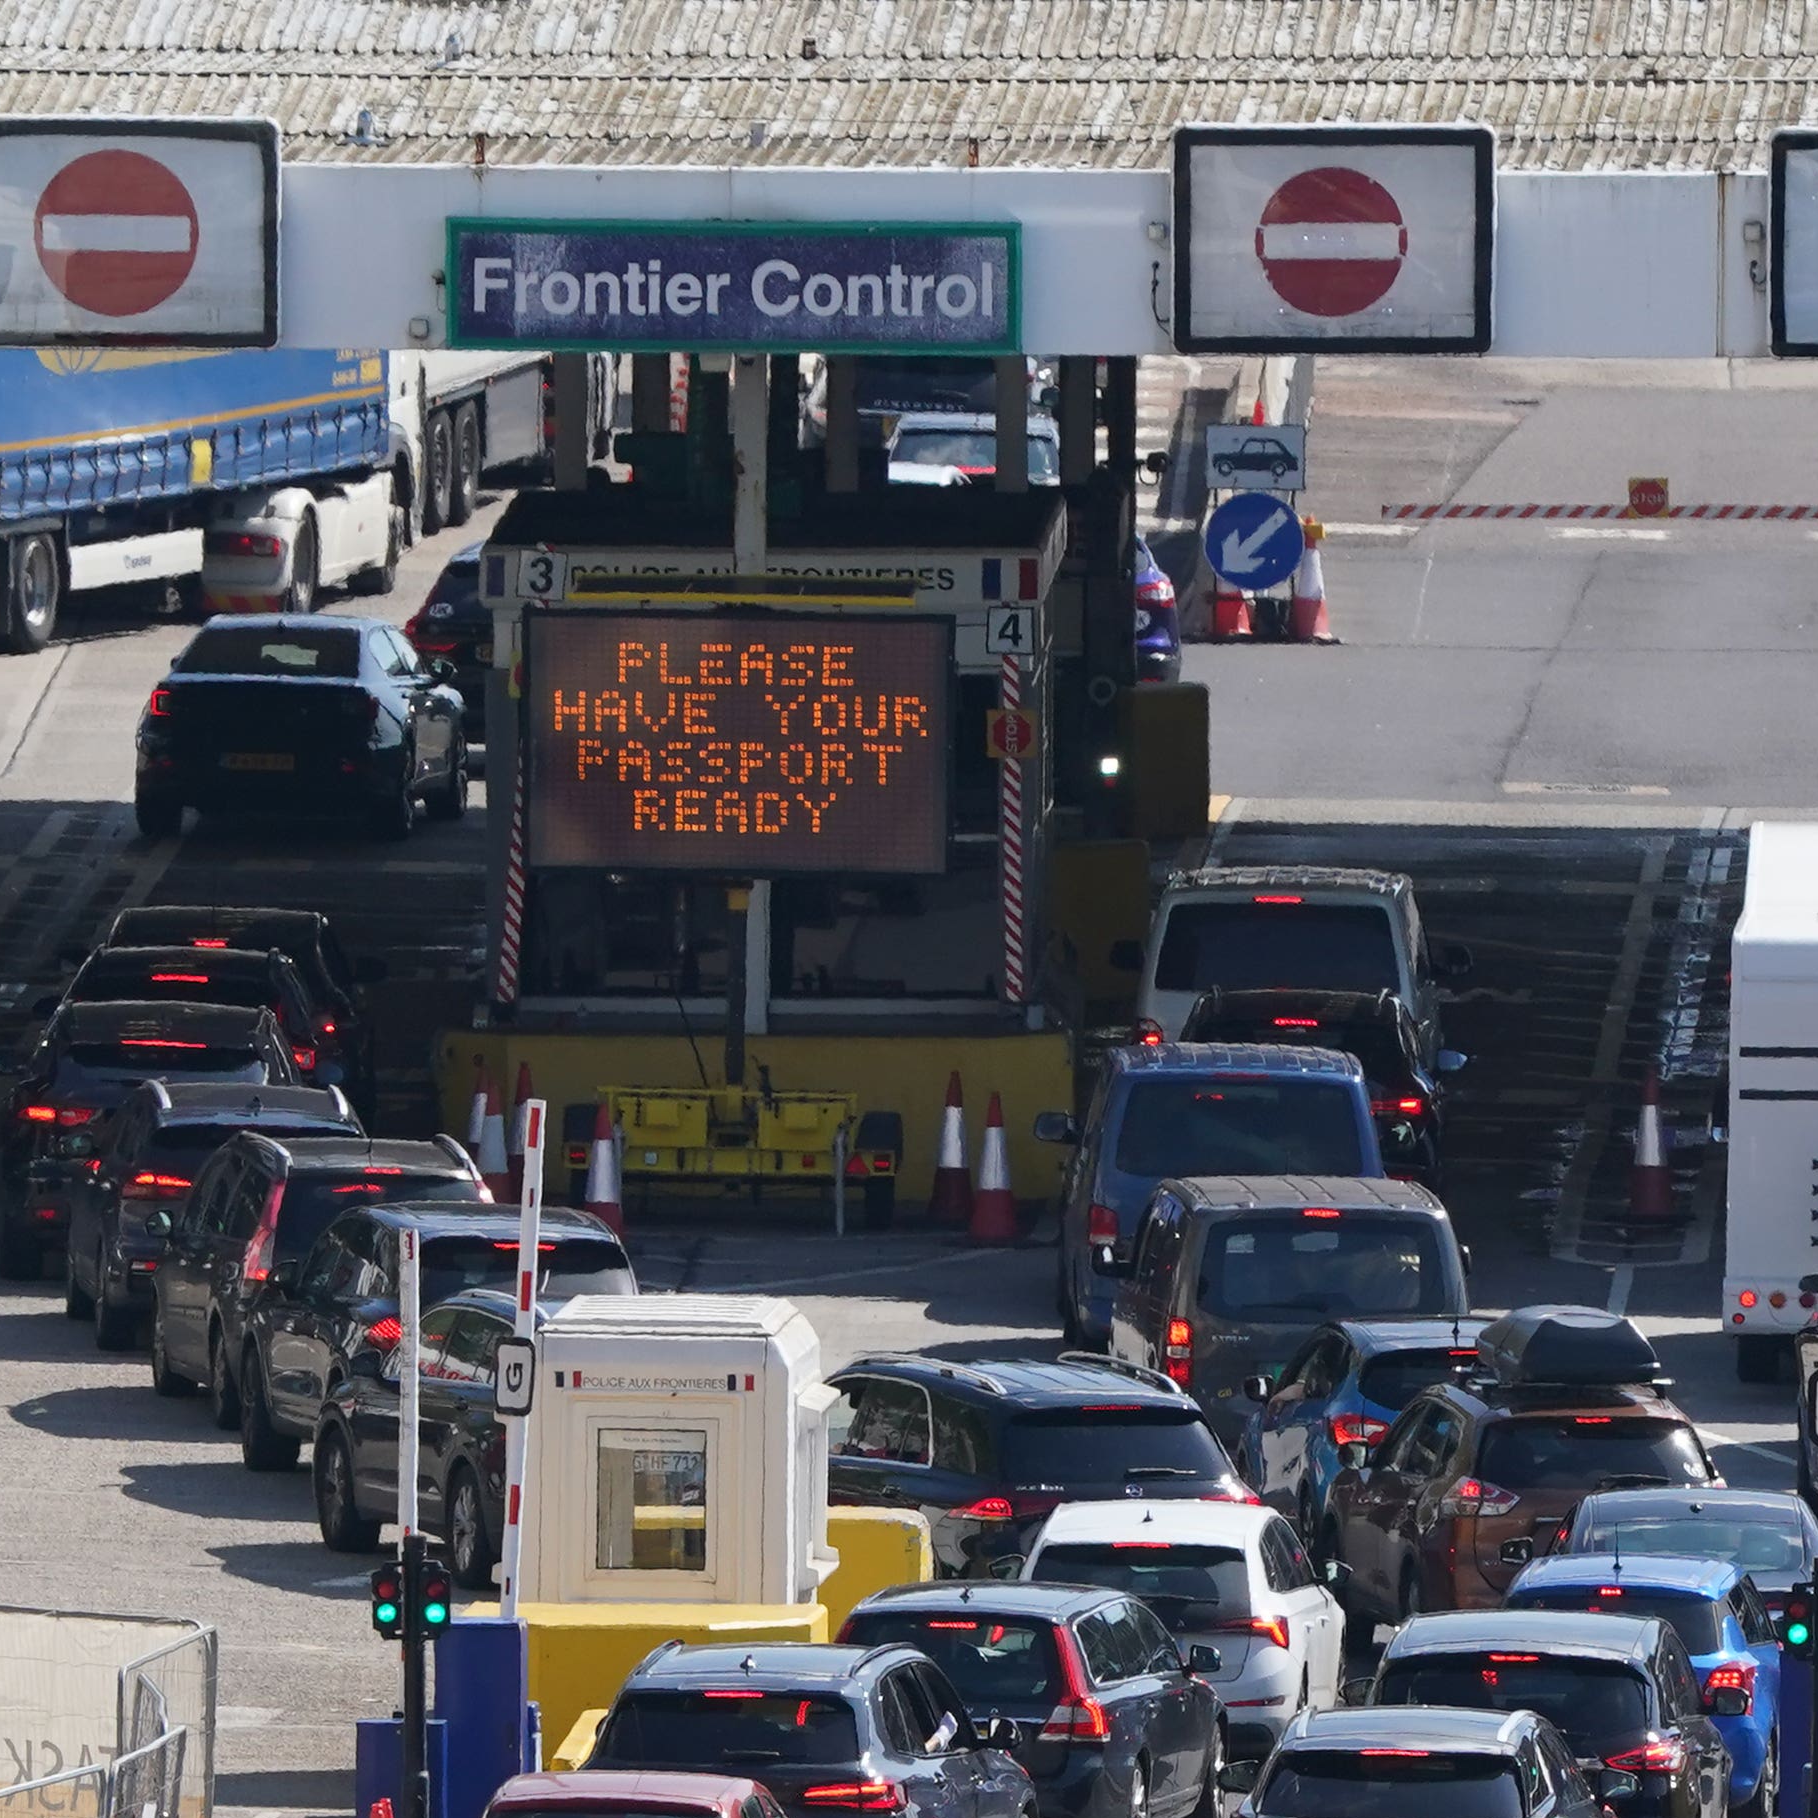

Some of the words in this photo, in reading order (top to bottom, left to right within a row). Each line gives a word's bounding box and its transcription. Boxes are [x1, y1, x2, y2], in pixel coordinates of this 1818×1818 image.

[472, 256, 731, 317] Frontier
[750, 258, 994, 319] Control
[530, 556, 555, 595] 3
[998, 613, 1023, 648] 4
[618, 641, 856, 686] PLEASE
[554, 689, 717, 735] HAVE
[765, 693, 929, 738] YOUR
[1005, 713, 1019, 754] STOP
[577, 738, 903, 786] PASSPORT
[633, 788, 838, 835] READY
[582, 1375, 626, 1389] POLICE
[628, 1377, 653, 1390] AUX
[655, 1377, 727, 1391] FRONTIERES
